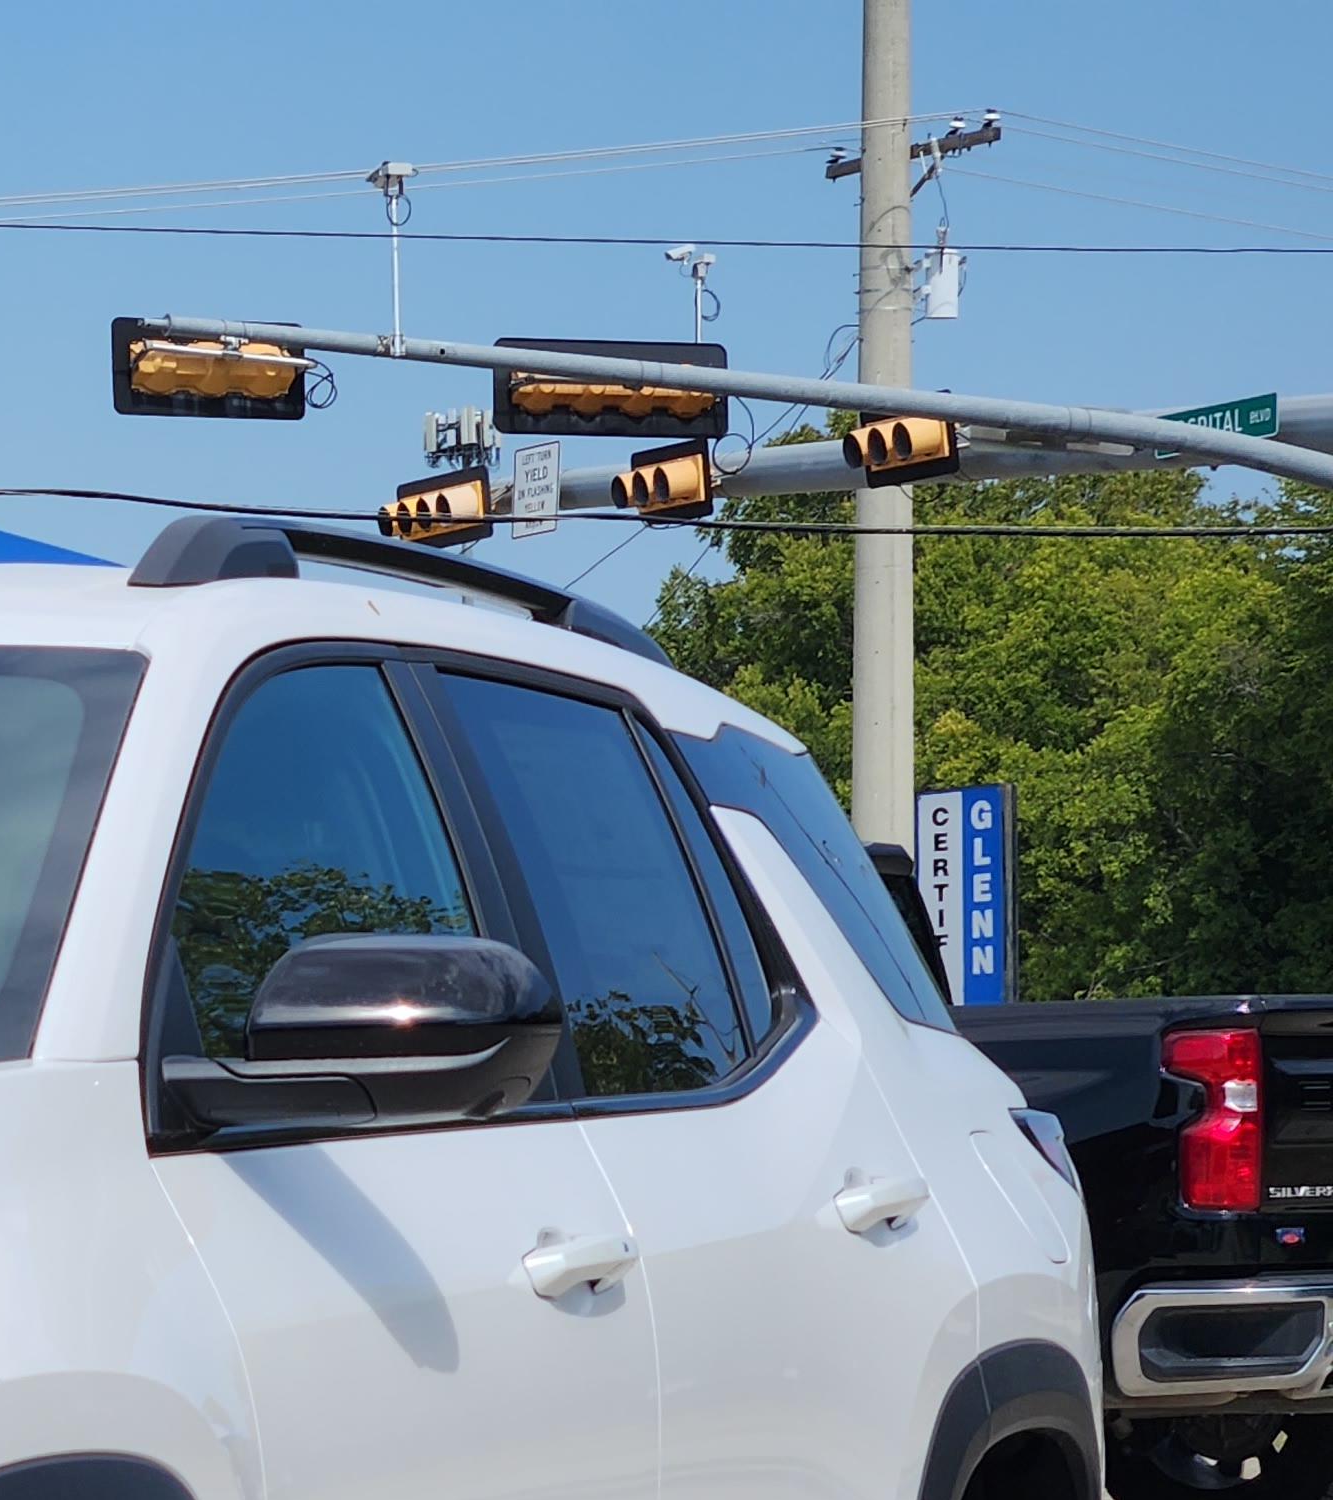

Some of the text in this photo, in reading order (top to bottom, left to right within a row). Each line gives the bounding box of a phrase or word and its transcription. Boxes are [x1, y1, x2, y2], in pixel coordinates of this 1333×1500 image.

[1249, 407, 1271, 425] BLVD
[522, 449, 552, 466] LEFT TURN
[525, 466, 549, 483] YIELD
[527, 482, 554, 498] FLASHING
[525, 500, 546, 513] YELLOW
[970, 799, 994, 975] GLENN
